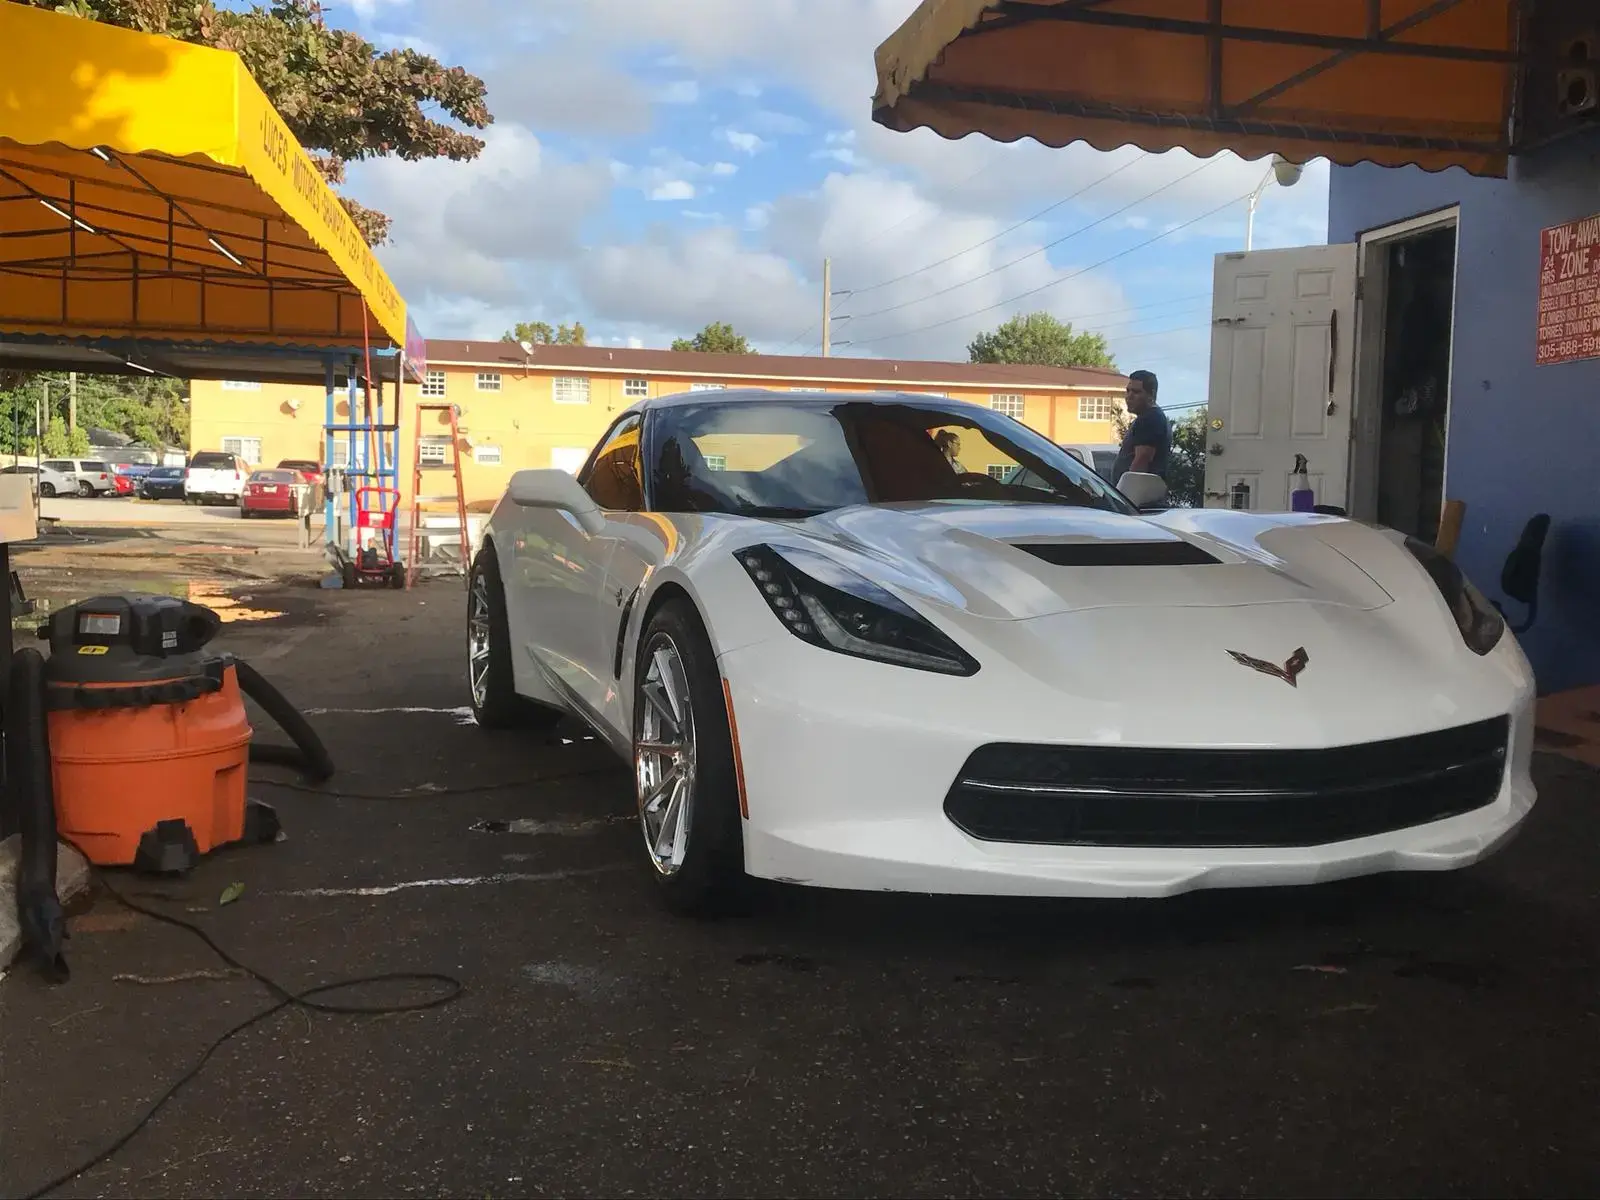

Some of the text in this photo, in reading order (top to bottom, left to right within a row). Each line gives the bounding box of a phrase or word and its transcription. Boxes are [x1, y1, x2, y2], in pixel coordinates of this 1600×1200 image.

[263, 110, 288, 176] LUCES
[294, 152, 320, 214] MOTORES
[1544, 254, 1555, 270] 24
[1560, 247, 1590, 279] ZONE
[1541, 269, 1556, 285] HRS
[1565, 319, 1591, 337] TOWING
[1539, 335, 1600, 359] 305-688-591
